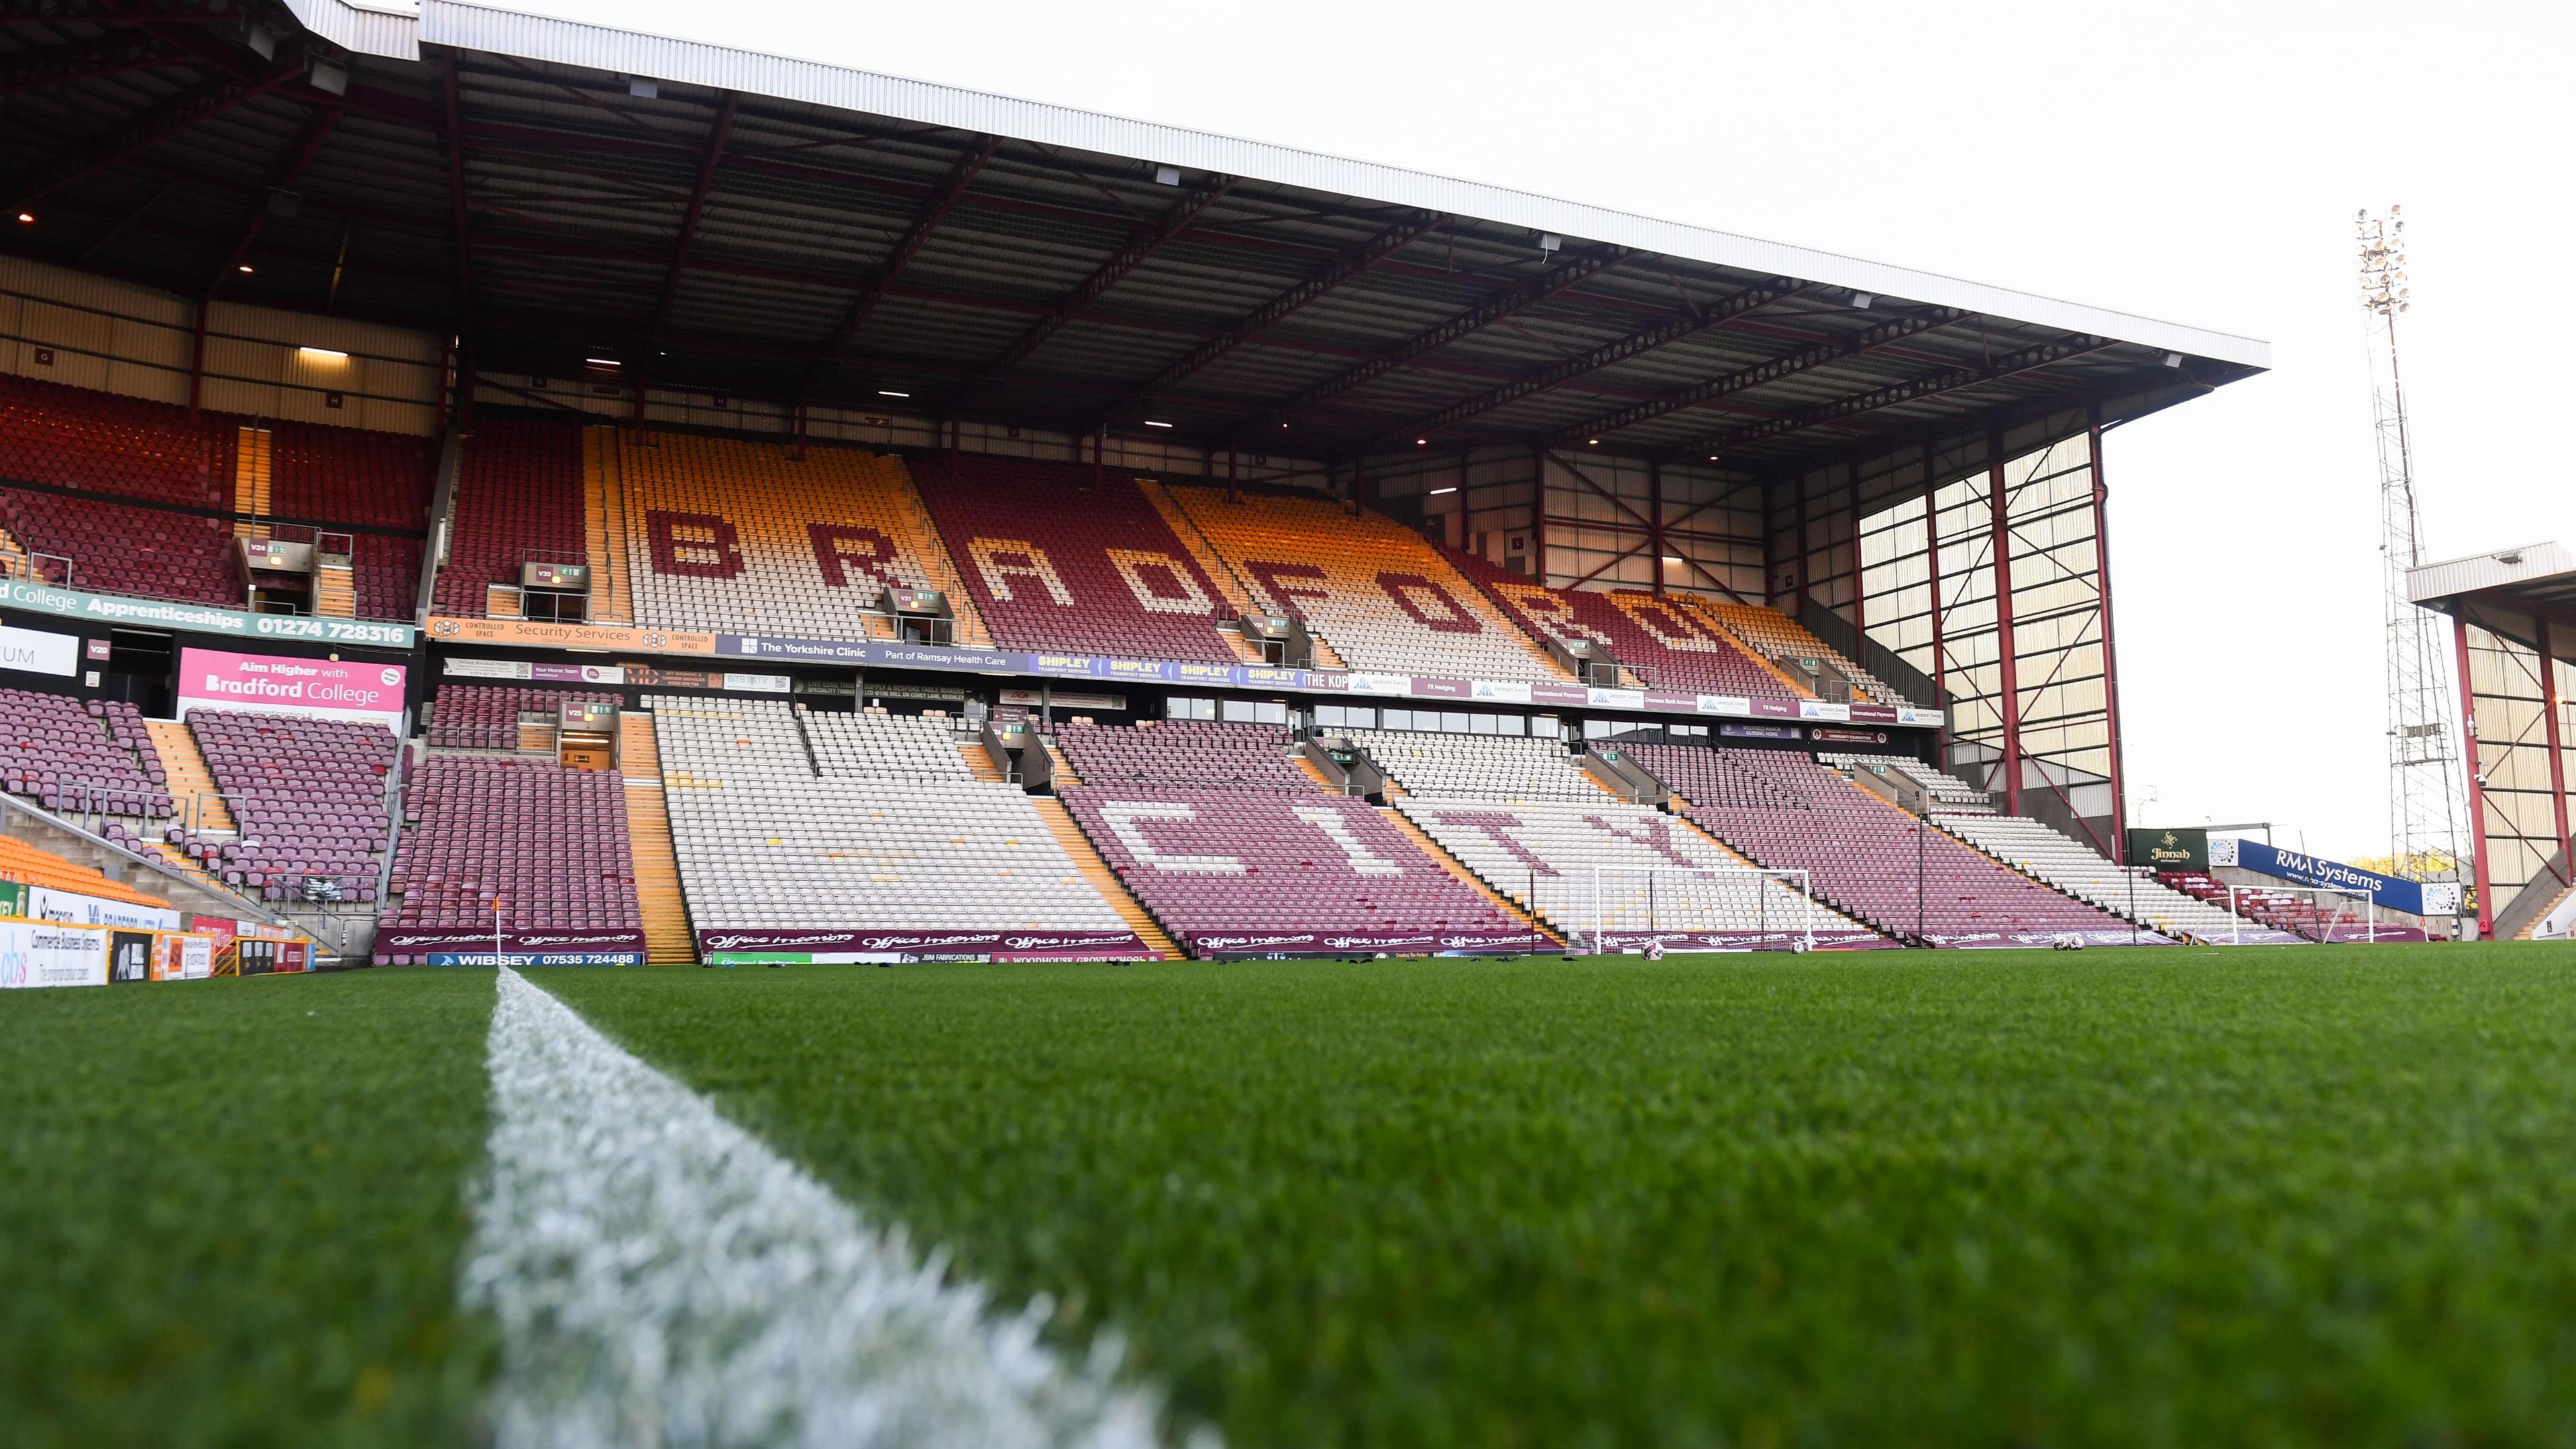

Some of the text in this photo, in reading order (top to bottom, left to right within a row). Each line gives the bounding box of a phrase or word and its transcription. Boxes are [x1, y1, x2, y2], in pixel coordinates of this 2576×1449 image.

[646, 507, 1723, 653] BRADFORD
[13, 586, 76, 611] College
[87, 598, 243, 629] Apprenticeships
[258, 618, 323, 637] 01274
[328, 623, 404, 643] 728316
[466, 622, 504, 630] CONTROLLED
[515, 624, 631, 641] Security Services
[672, 635, 708, 643] CONTROLLED
[90, 646, 107, 654] V20
[761, 643, 1006, 666] The Yorkshire Clinic Part of Ramsay Health Care
[1038, 655, 1091, 668] SHIPLEY
[1110, 660, 1161, 673] SHIPLEY
[239, 661, 347, 678] Aim Higher with
[1180, 665, 1230, 678] SHIPLEY
[1248, 669, 1296, 681] SHIPLEY
[1306, 674, 1348, 688] THE KOP
[205, 674, 379, 706] Bradford College
[1434, 684, 1456, 693] Hedging
[1534, 690, 1586, 700] International Payments
[1099, 800, 1717, 876] CITY
[2151, 848, 2190, 860] Jinnah
[2276, 850, 2382, 891] RMA Systems
[706, 934, 769, 949] Office
[862, 936, 923, 949] Office
[1005, 937, 1060, 949] Office
[1197, 936, 1248, 949] Office
[1324, 938, 1372, 948] Office
[1, 931, 27, 984] cbs
[458, 955, 634, 965] WIBSEY 07535 724488
